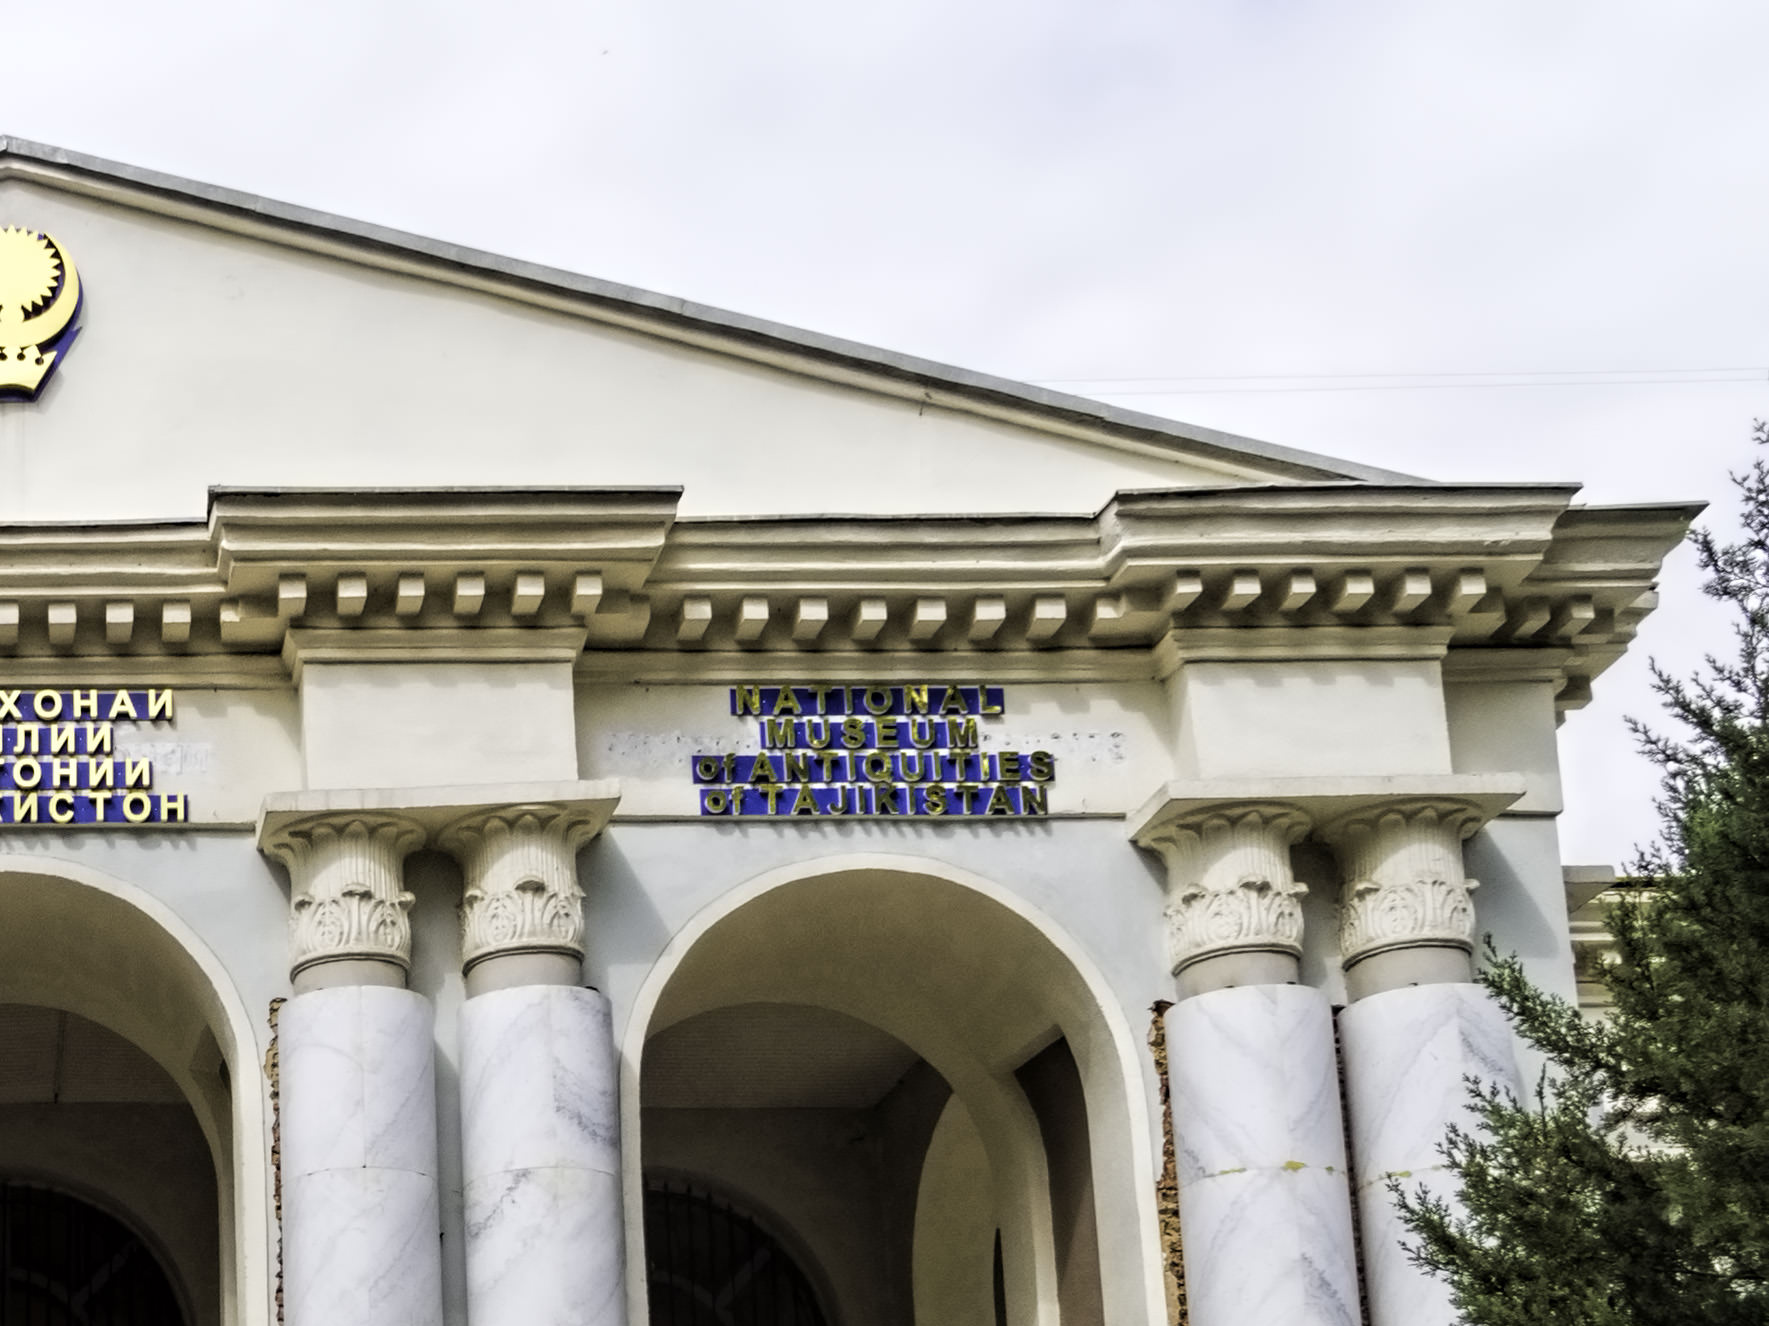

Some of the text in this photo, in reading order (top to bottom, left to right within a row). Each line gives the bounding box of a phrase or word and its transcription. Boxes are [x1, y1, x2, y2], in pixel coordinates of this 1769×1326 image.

[734, 685, 1004, 716] NATIONAL
[765, 717, 979, 749] MUSEUM
[695, 750, 1056, 785] of ANTIQUITIES
[704, 785, 1049, 816] of TAJIKISTAN
